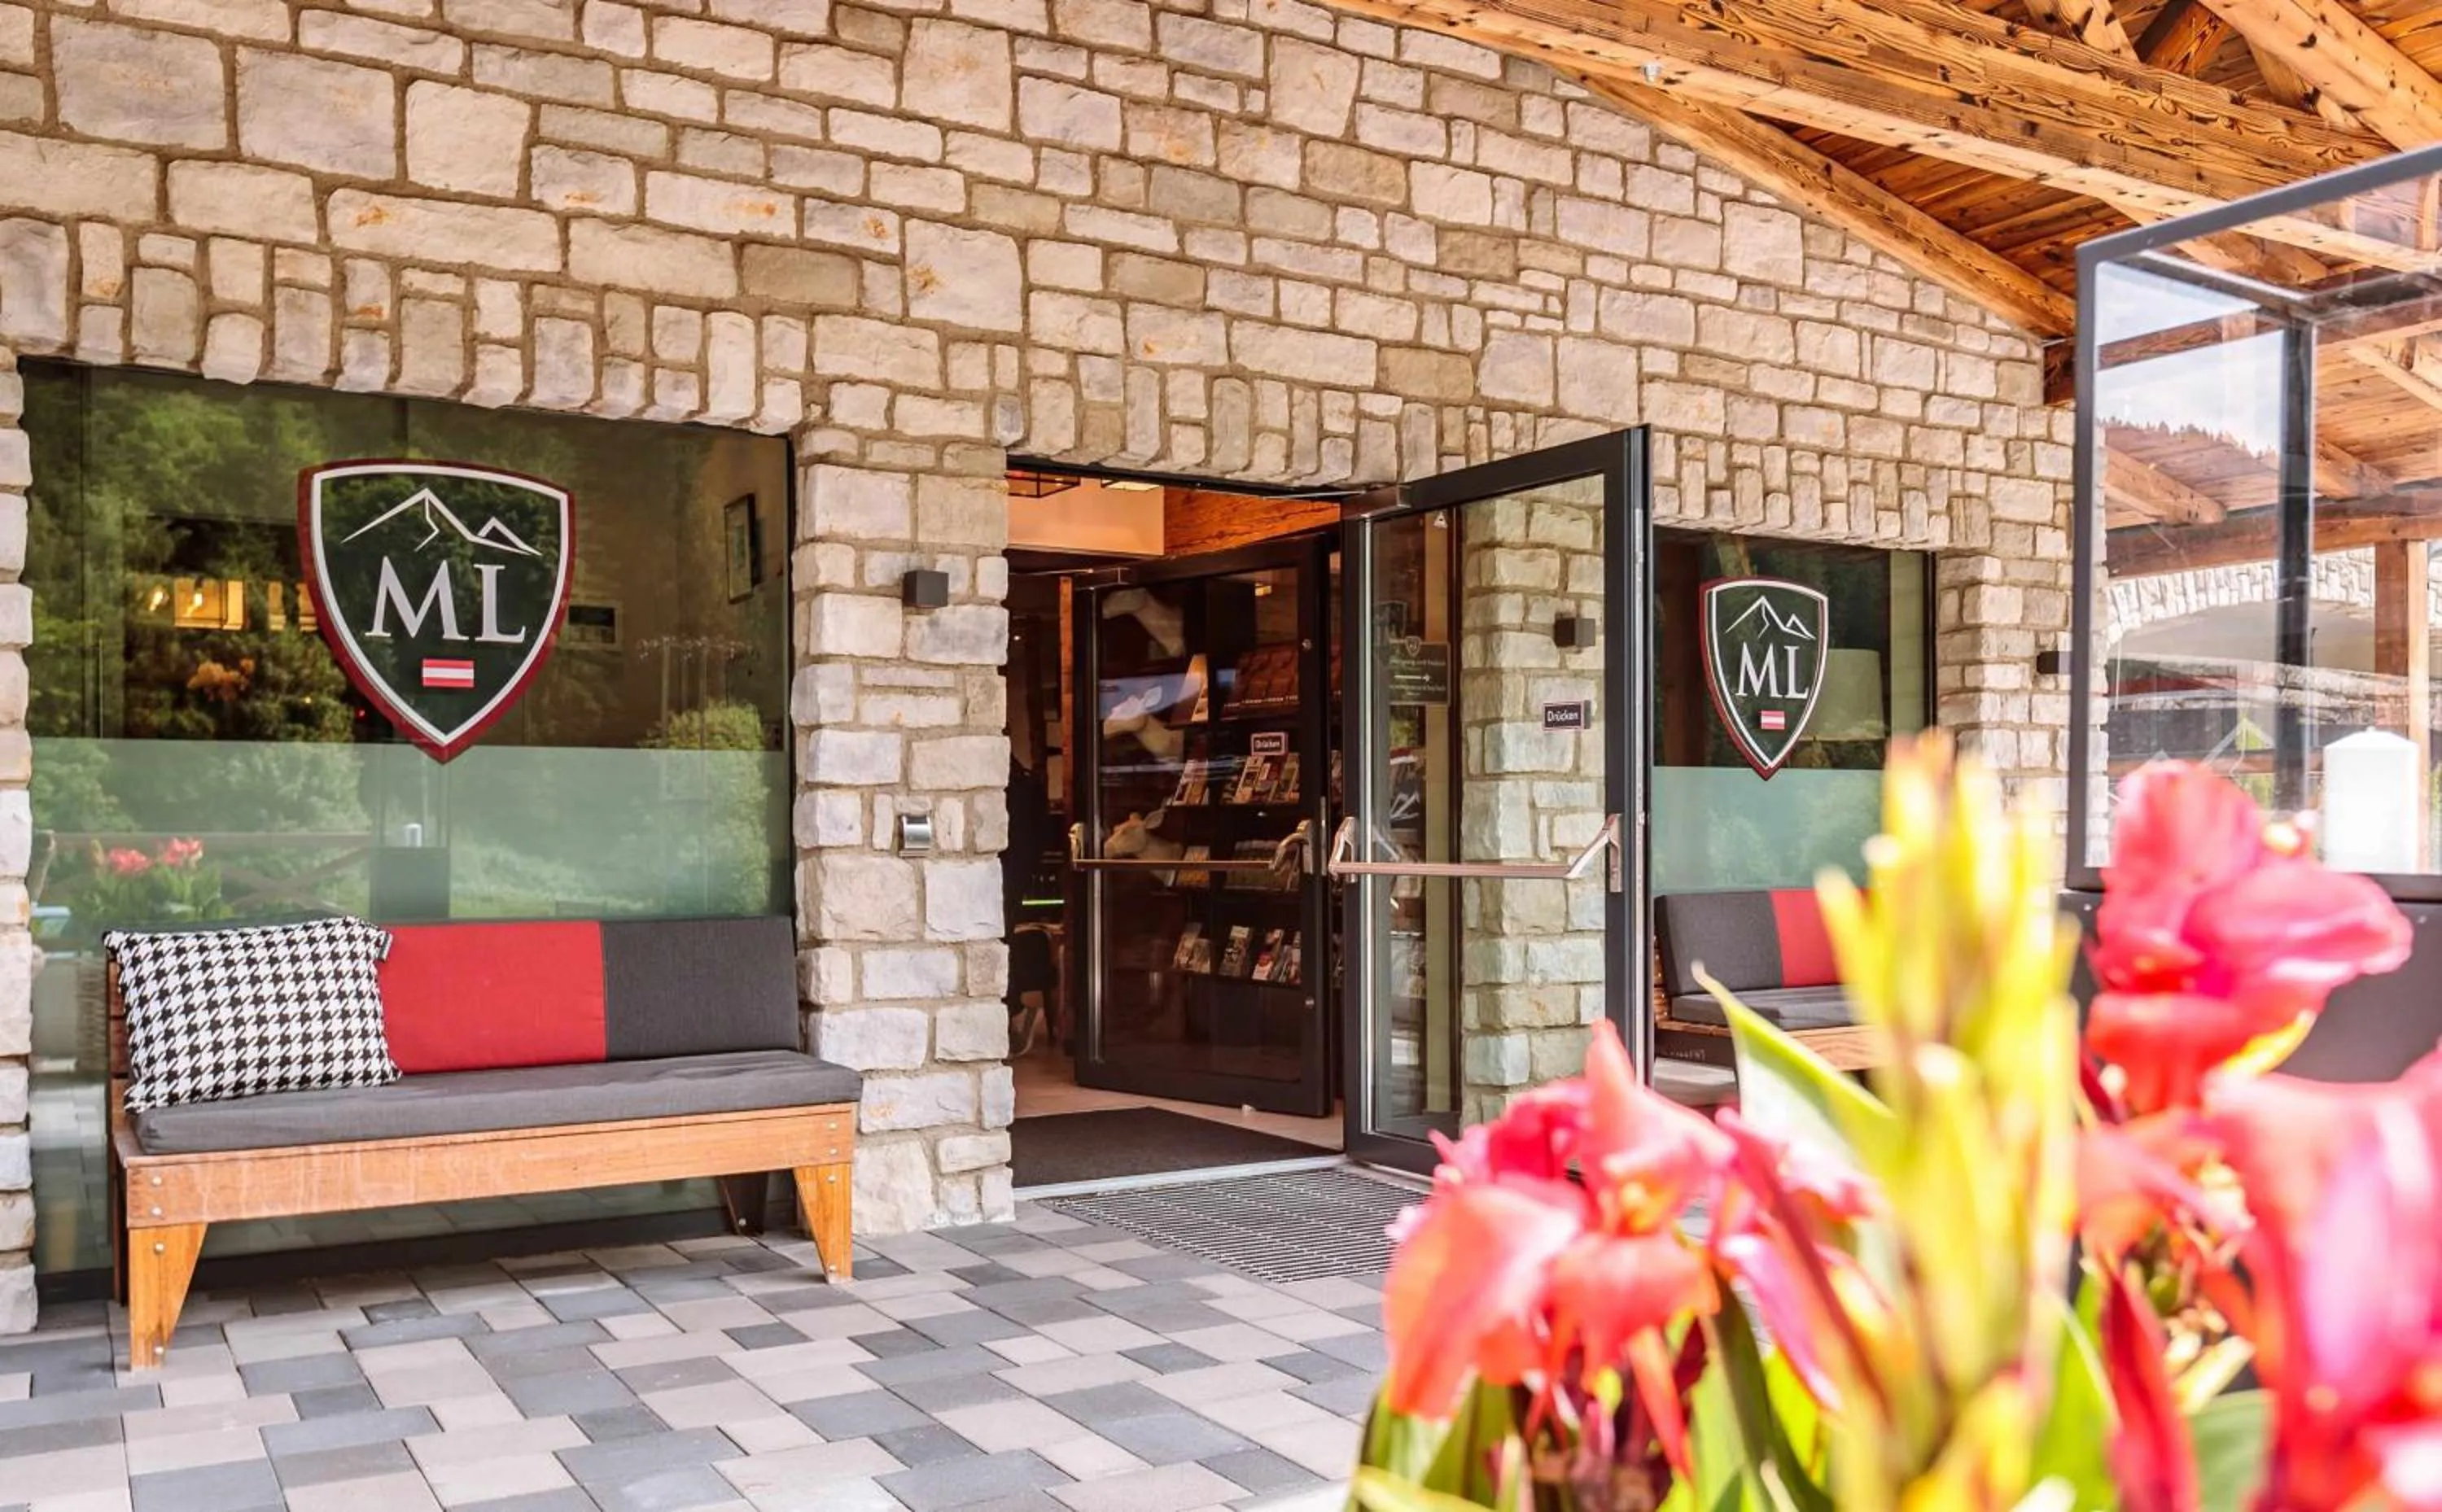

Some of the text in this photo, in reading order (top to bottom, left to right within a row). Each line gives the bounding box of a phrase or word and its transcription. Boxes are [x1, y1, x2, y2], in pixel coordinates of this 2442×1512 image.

[365, 556, 526, 643] ML
[1735, 642, 1809, 699] ML
[1547, 709, 1578, 722] Drücken
